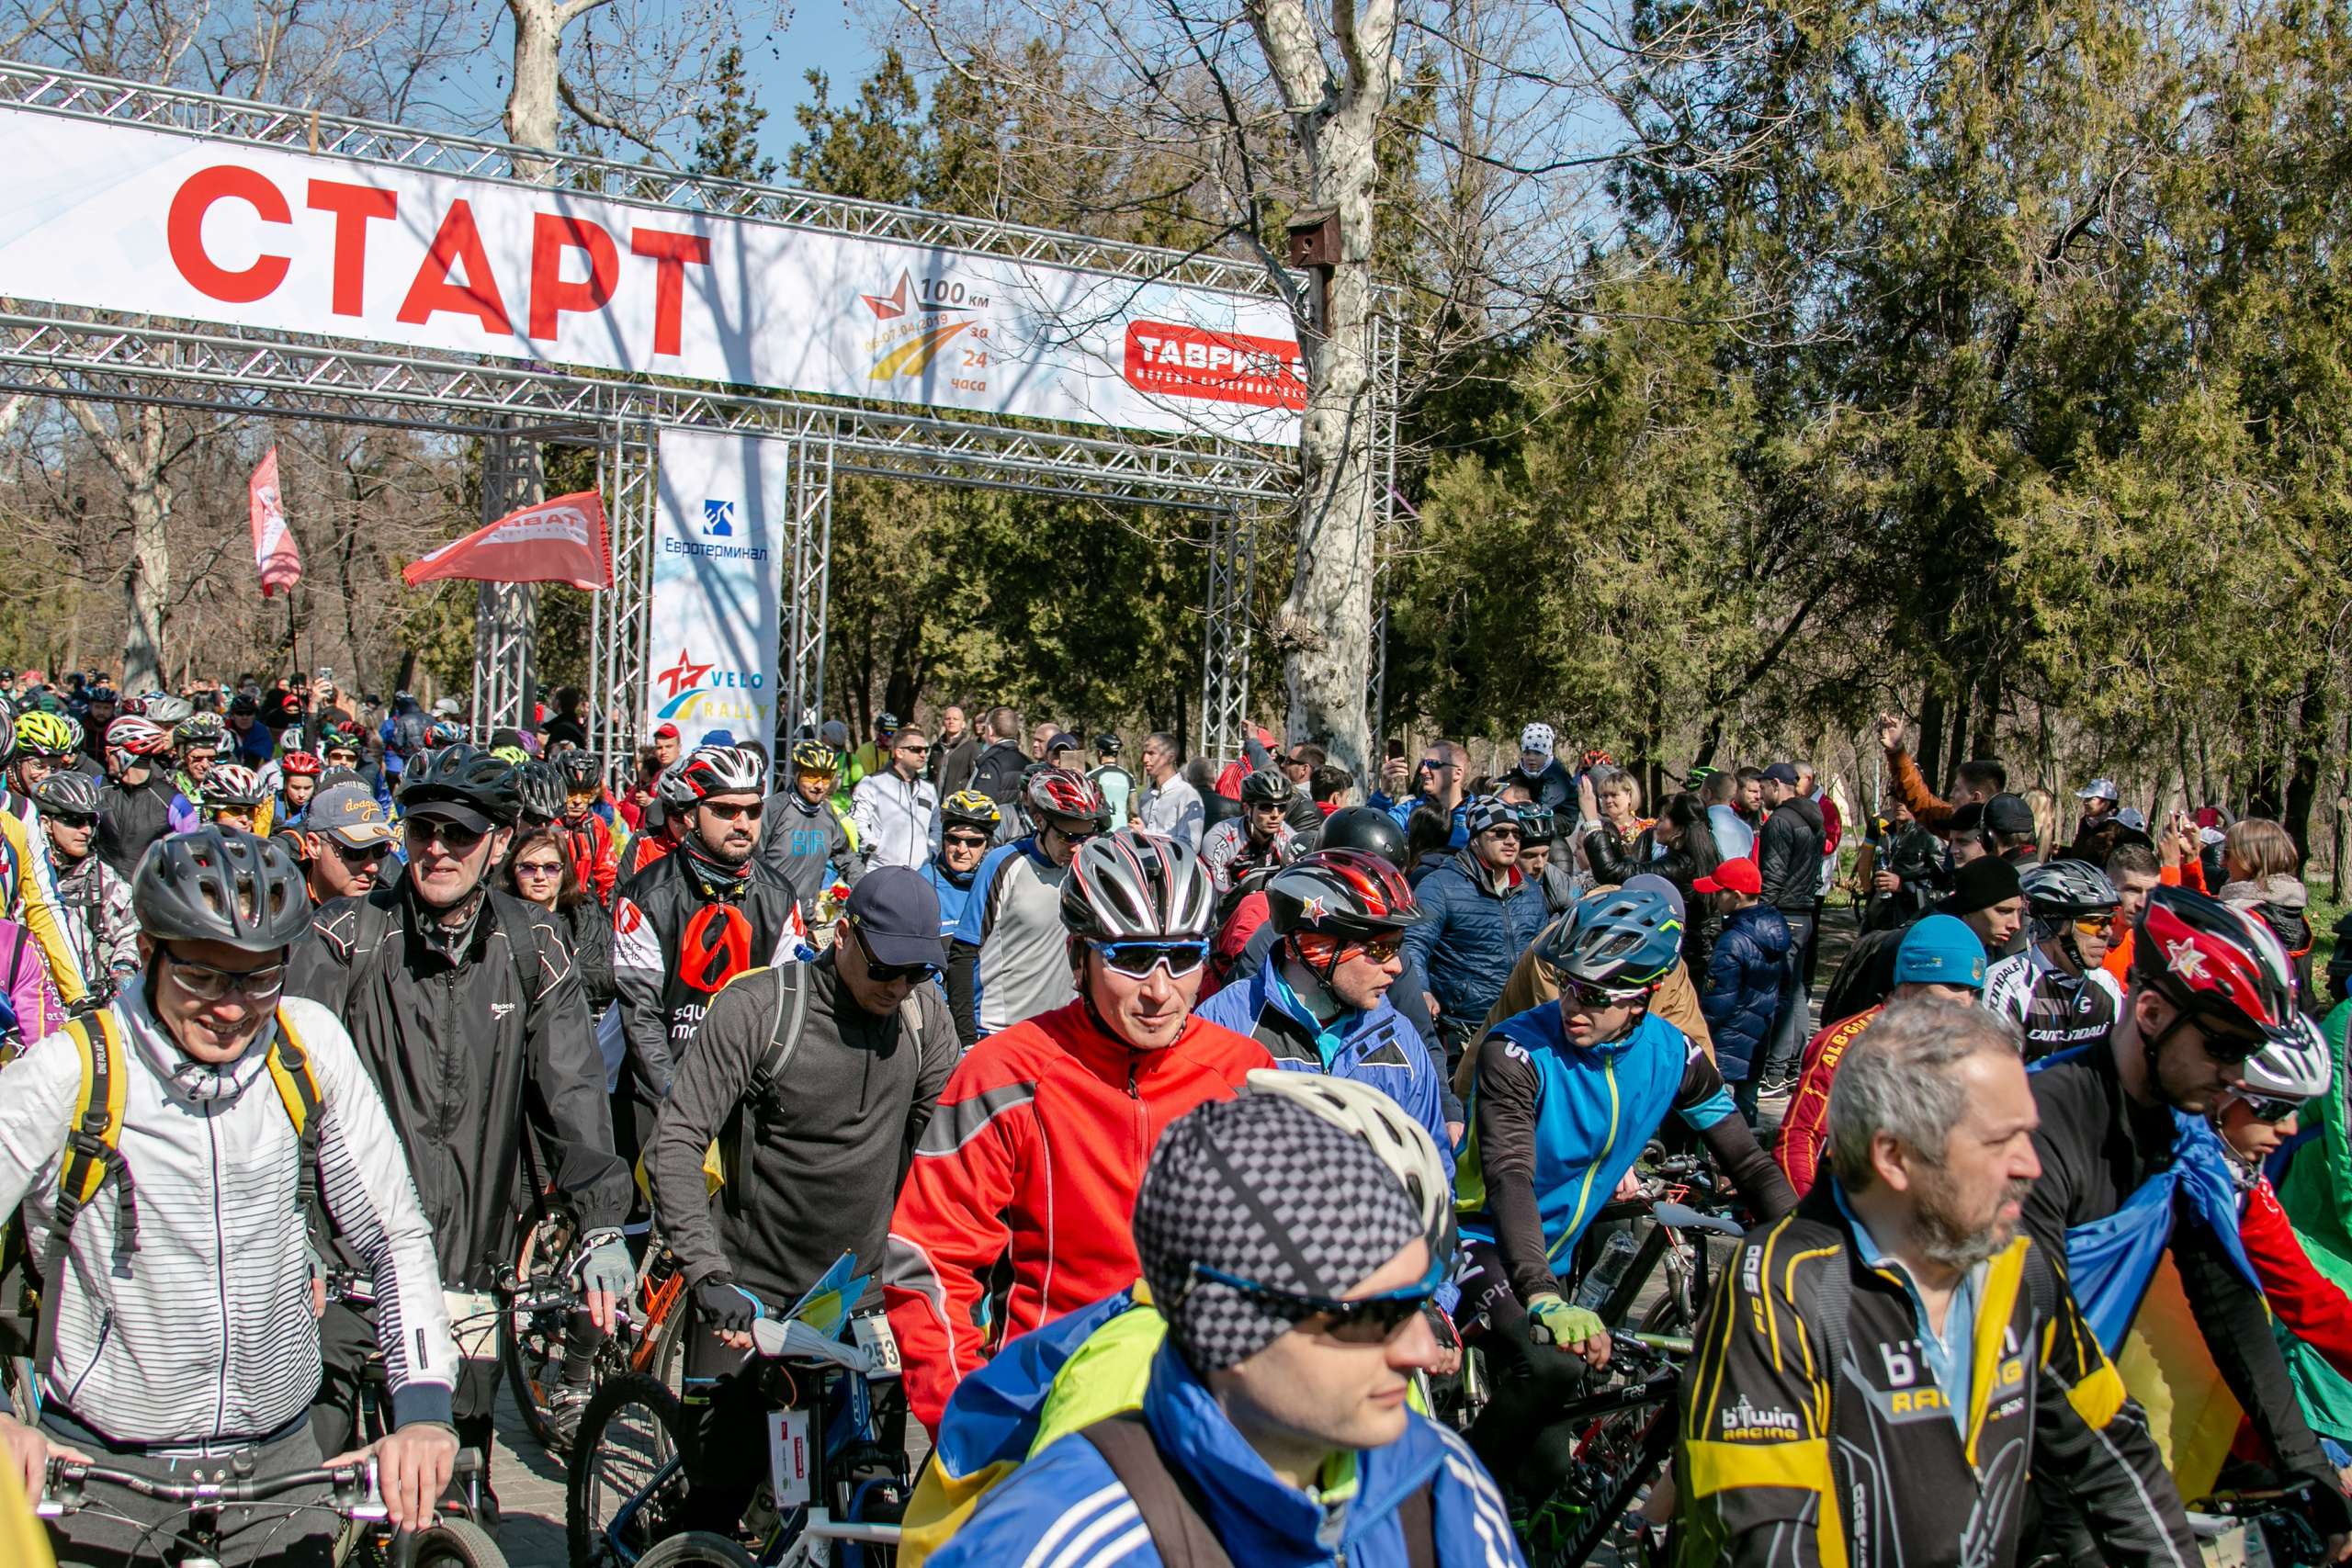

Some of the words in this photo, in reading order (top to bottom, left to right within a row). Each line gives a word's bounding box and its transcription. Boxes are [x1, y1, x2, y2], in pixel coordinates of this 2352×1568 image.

[168, 164, 711, 356] СТАРТ
[922, 278, 965, 303] 100
[967, 295, 989, 308] км
[865, 313, 948, 353] 06-07.04.2019
[970, 327, 989, 339] за
[963, 350, 988, 367] 24
[951, 378, 987, 391] часа
[665, 537, 767, 560] Евротерминал
[711, 671, 763, 689] VELO
[704, 702, 769, 720] RALLY
[862, 1339, 899, 1368] 253
[1623, 1383, 1646, 1402] F29
[1723, 1427, 1800, 1441] RACING
